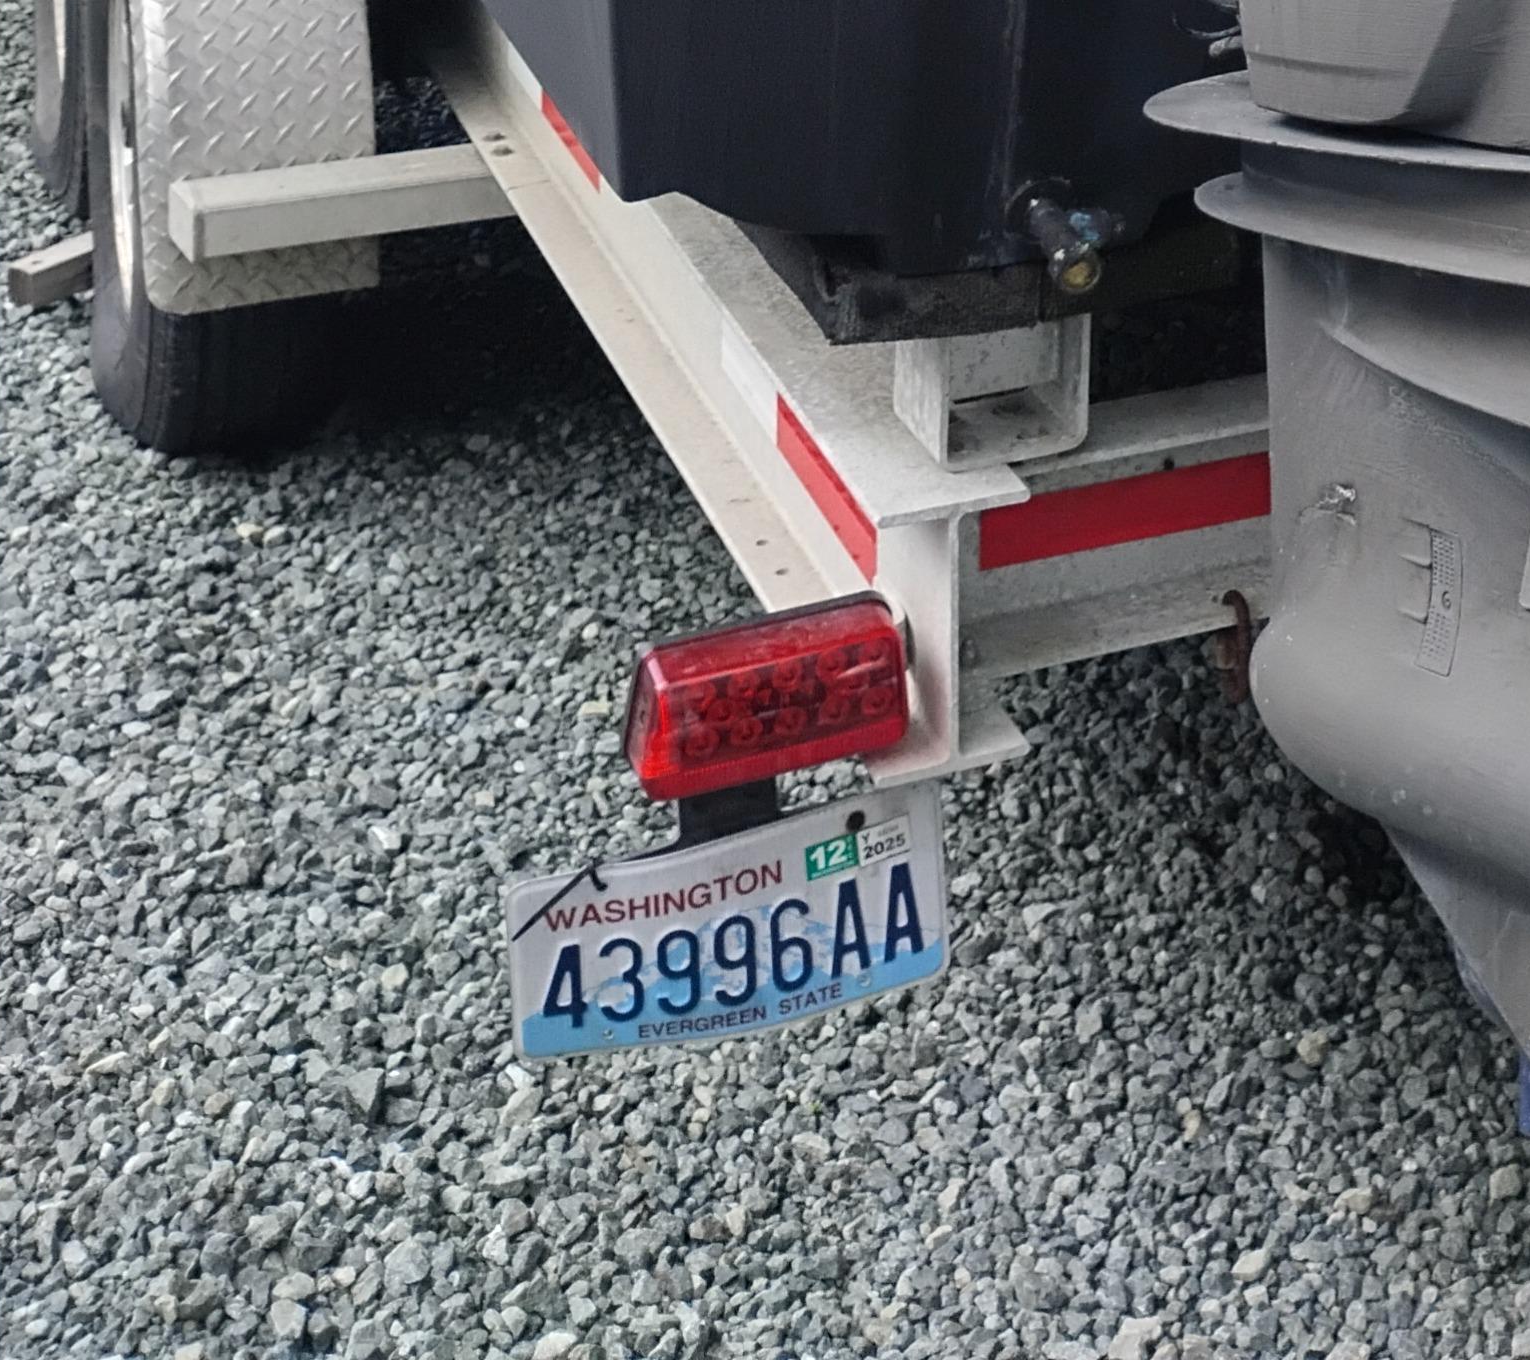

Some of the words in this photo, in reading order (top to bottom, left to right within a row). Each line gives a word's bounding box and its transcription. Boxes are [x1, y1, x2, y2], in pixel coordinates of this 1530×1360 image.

[810, 839, 848, 870] 12
[863, 833, 907, 860] 2025
[543, 860, 784, 932] WASHINGTON
[542, 862, 925, 1028] 43996AA
[638, 1005, 768, 1039] EVERGREEN
[778, 982, 843, 1016] STATE
